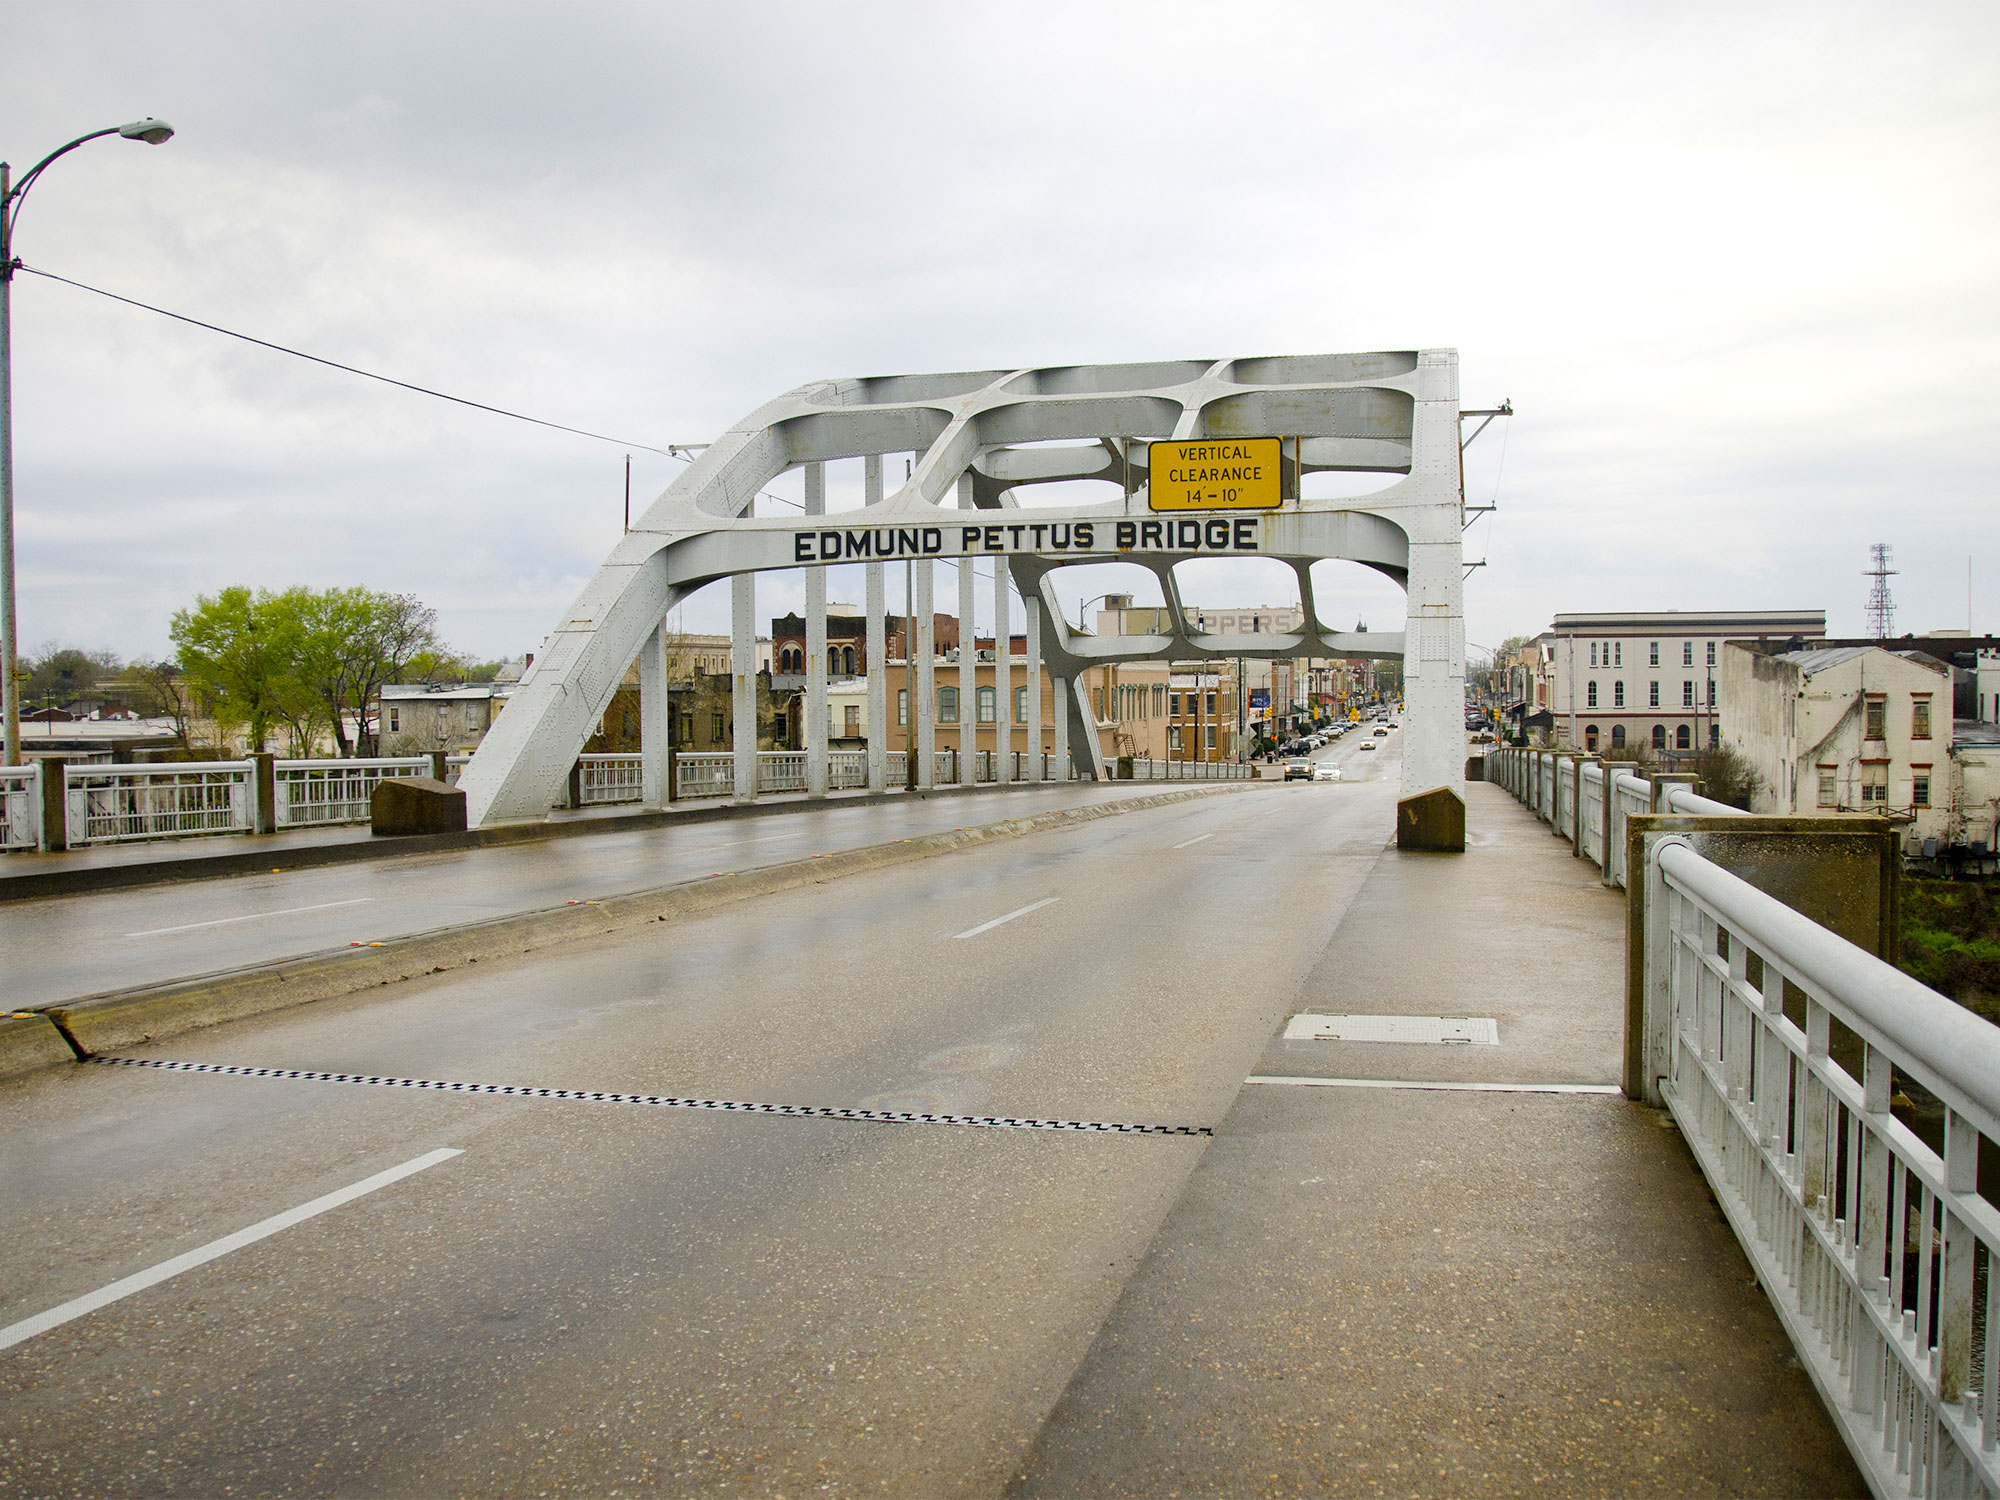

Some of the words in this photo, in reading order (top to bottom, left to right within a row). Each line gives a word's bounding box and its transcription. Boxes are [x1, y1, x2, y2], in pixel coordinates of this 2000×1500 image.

[1178, 446, 1252, 461] VERTICAL
[1169, 467, 1262, 482] CLEARANCE
[795, 527, 942, 562] EDMUND
[962, 523, 1094, 552] PETTUS
[1116, 519, 1258, 550] BRIDGE
